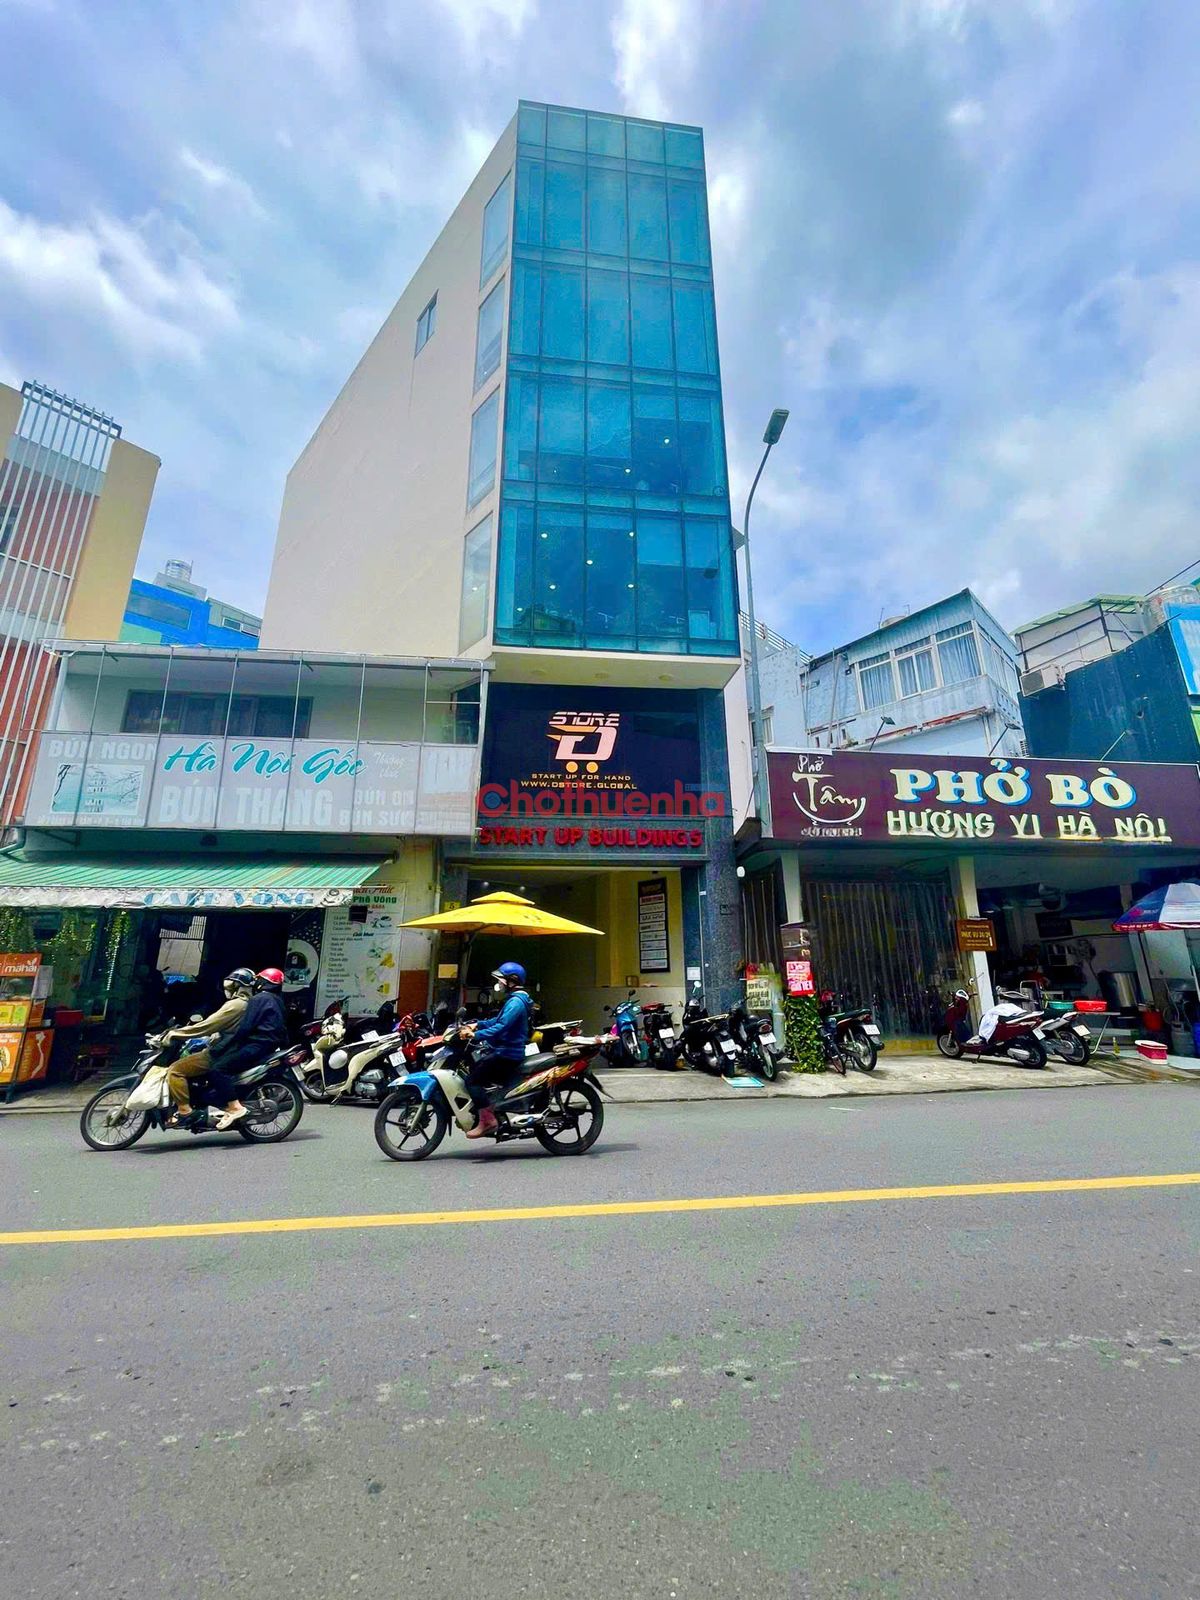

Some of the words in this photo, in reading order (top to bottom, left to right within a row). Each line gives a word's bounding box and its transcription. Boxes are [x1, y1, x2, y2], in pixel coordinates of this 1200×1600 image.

[164, 741, 219, 772] Hà
[231, 742, 296, 779] Nội
[302, 748, 367, 784] Gốc
[797, 754, 824, 773] Phở
[159, 779, 224, 824] BÚN
[236, 786, 335, 826] THANG
[520, 781, 637, 789] WWW.DSTORE.GLOBAL
[792, 771, 858, 812] Tâm
[889, 758, 1032, 806] PHỞ
[1045, 767, 1137, 809] BÒ
[479, 826, 547, 846] START
[554, 828, 583, 847] UP
[588, 828, 703, 848] BUILDINGS
